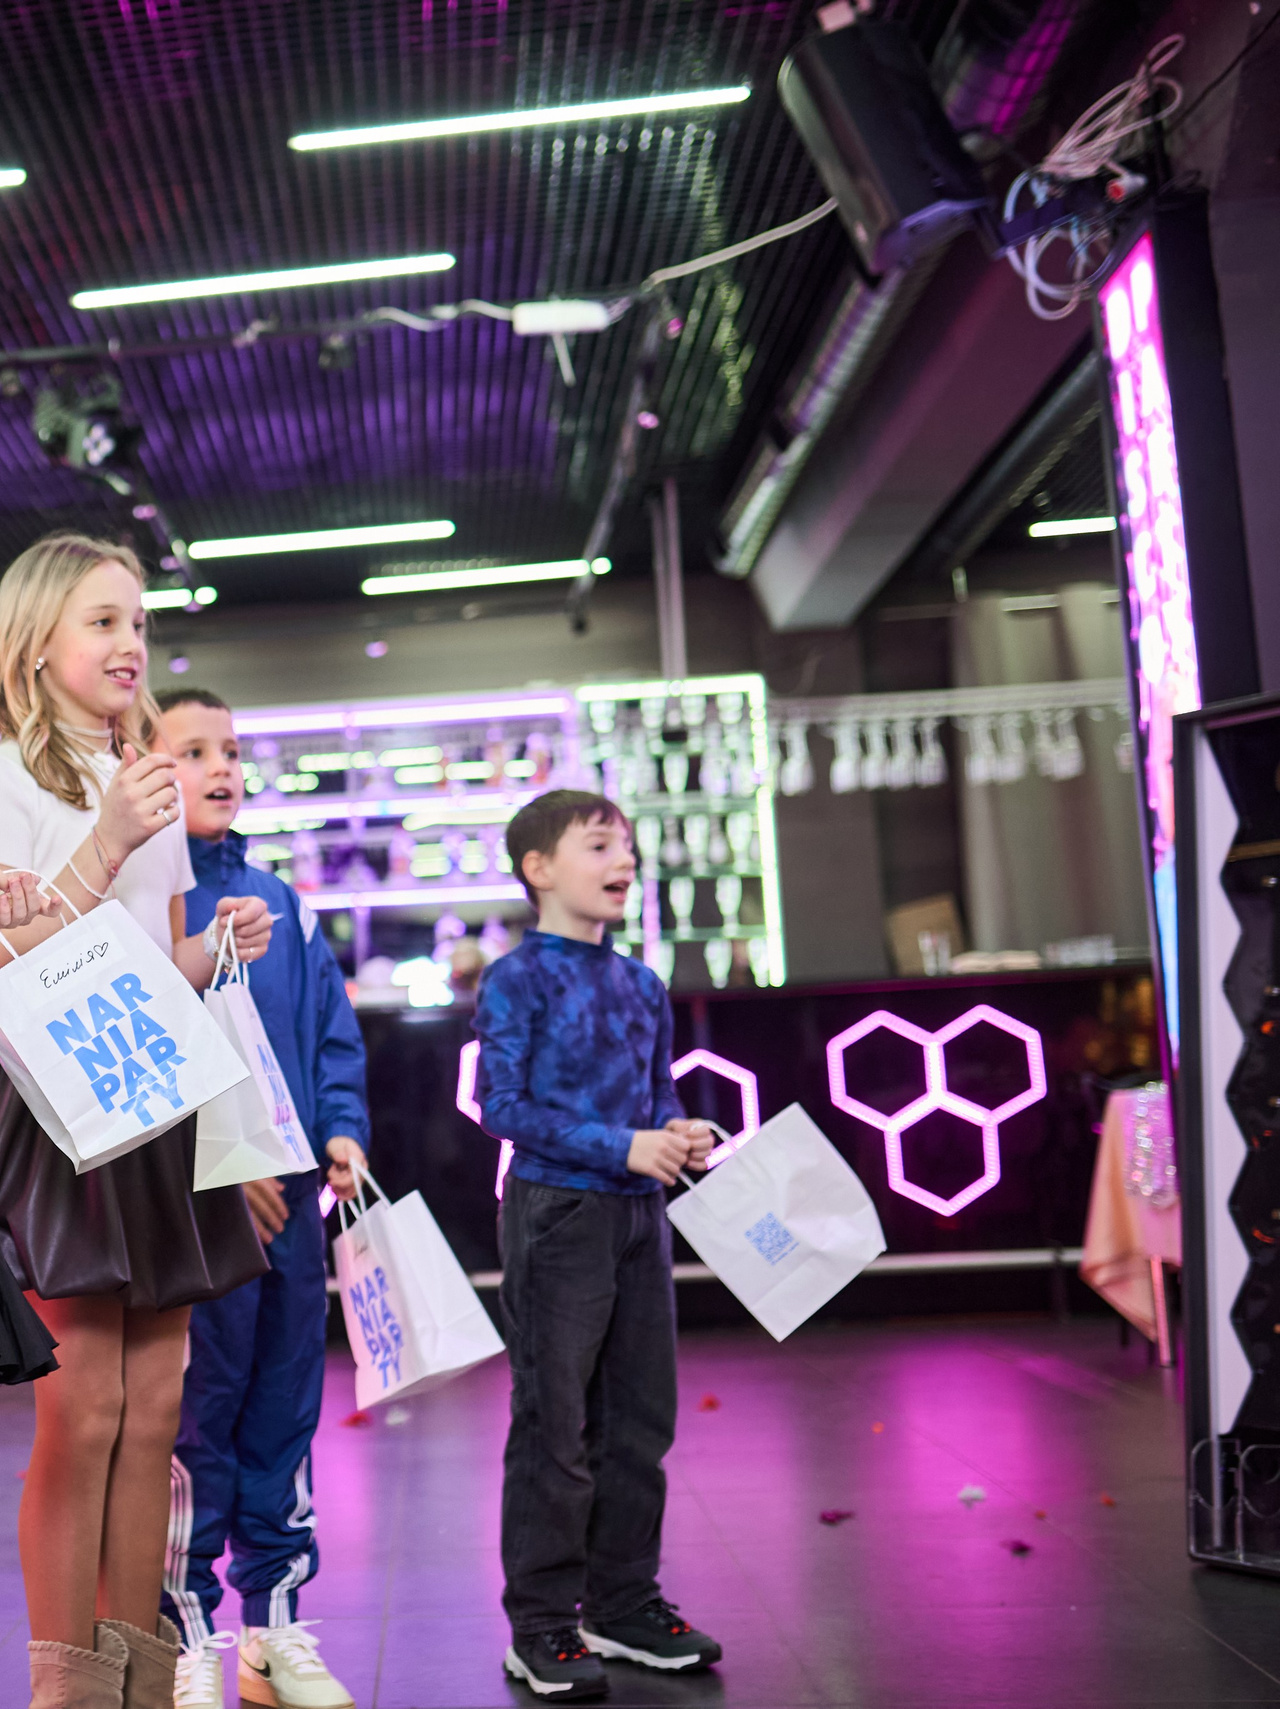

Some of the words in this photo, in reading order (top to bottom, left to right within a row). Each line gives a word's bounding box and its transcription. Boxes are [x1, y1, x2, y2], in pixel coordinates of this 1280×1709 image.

[46, 973, 153, 1056] NAR
[73, 1009, 167, 1082] NIA
[90, 1037, 187, 1114] PAR
[120, 1069, 185, 1127] TY
[349, 1266, 389, 1314] NAR
[359, 1297, 395, 1339] NIA
[367, 1322, 404, 1365] PAR
[378, 1352, 401, 1389] TY
